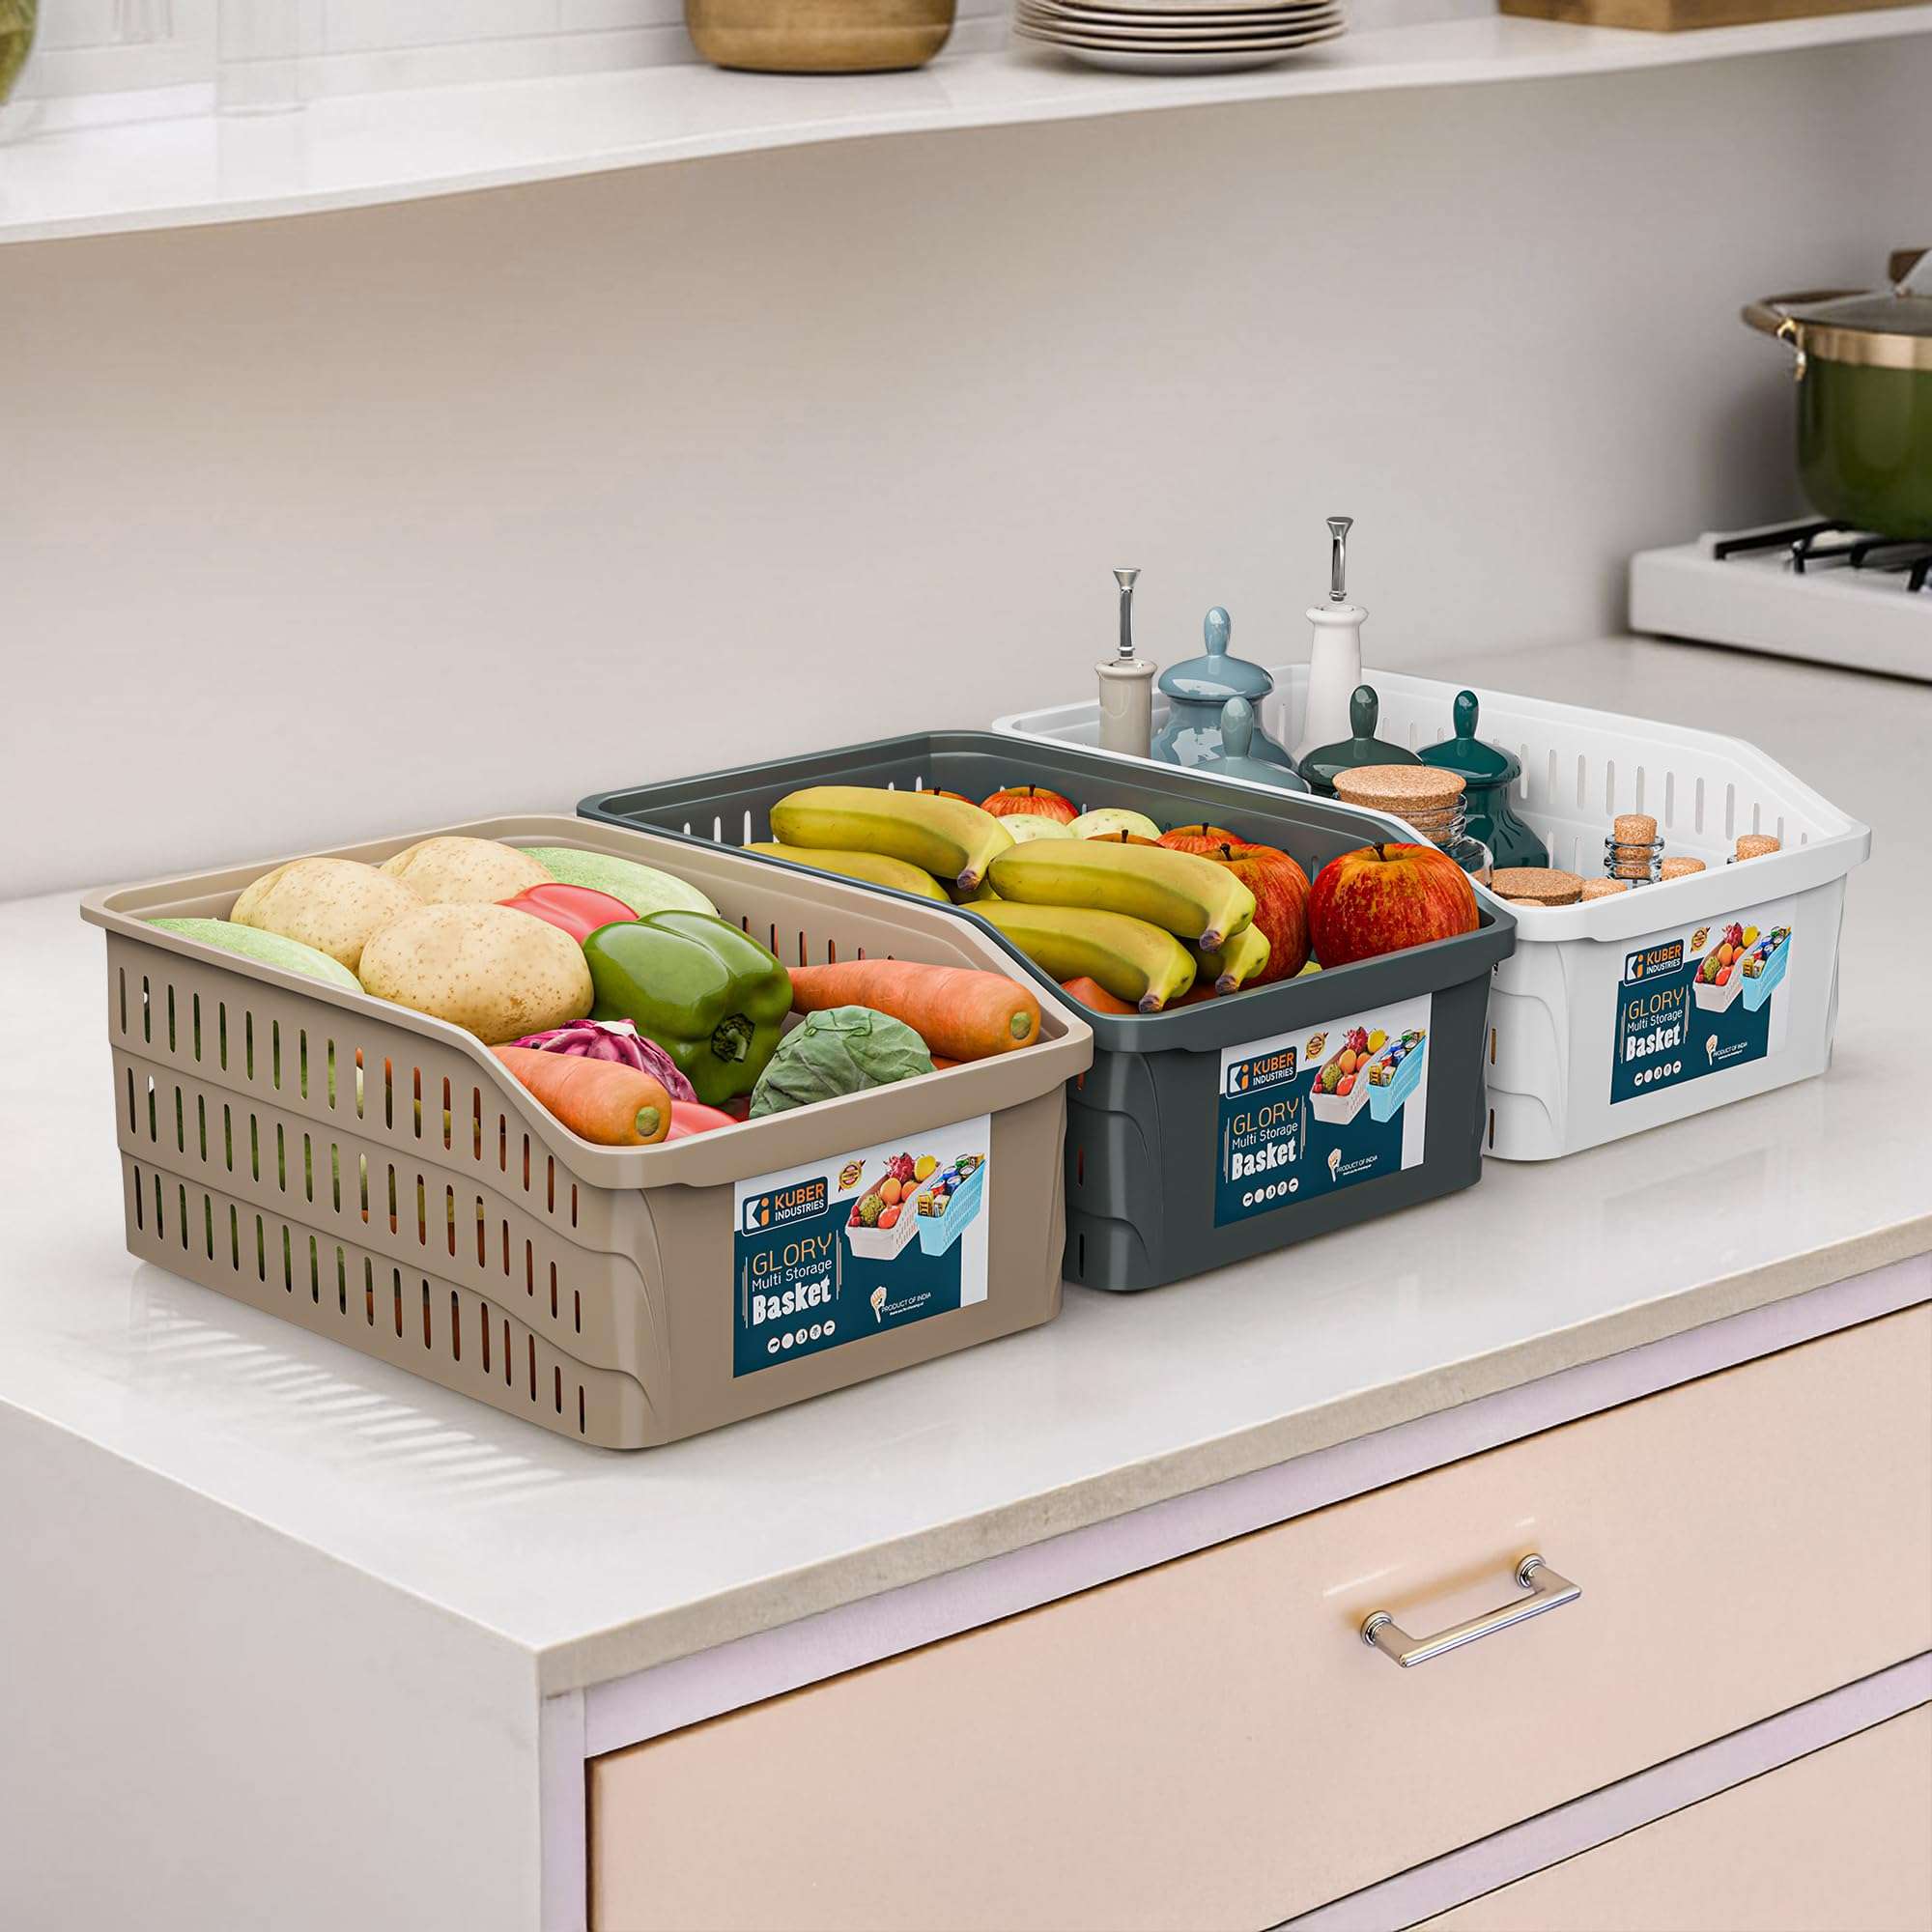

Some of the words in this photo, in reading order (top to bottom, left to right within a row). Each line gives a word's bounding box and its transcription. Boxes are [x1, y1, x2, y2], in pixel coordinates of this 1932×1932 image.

[1646, 945, 1681, 965] KUBER
[1646, 958, 1681, 975] INDUSTRIES
[1629, 987, 1684, 1019] GLORY
[1627, 1017, 1648, 1034] Multi
[1650, 1009, 1683, 1027] Storage
[1626, 1022, 1681, 1062] Basket
[1253, 1052, 1294, 1076] KUBER
[1253, 1066, 1293, 1086] INDUSTRIES
[1233, 1097, 1299, 1135] GLORY
[1232, 1132, 1257, 1150] Multi
[1260, 1122, 1298, 1142] Storage
[1232, 1136, 1296, 1180] Basket
[1365, 1154, 1378, 1163] INDIA
[775, 1182, 825, 1210] KUBER
[775, 1199, 825, 1221] INDUSTRIES
[753, 1232, 833, 1275] GLORY
[753, 1272, 781, 1293] Multi
[785, 1259, 833, 1281] Storage
[753, 1274, 831, 1325] Basket
[881, 1298, 909, 1313] PRODUCT
[917, 1292, 932, 1301] INDIA
